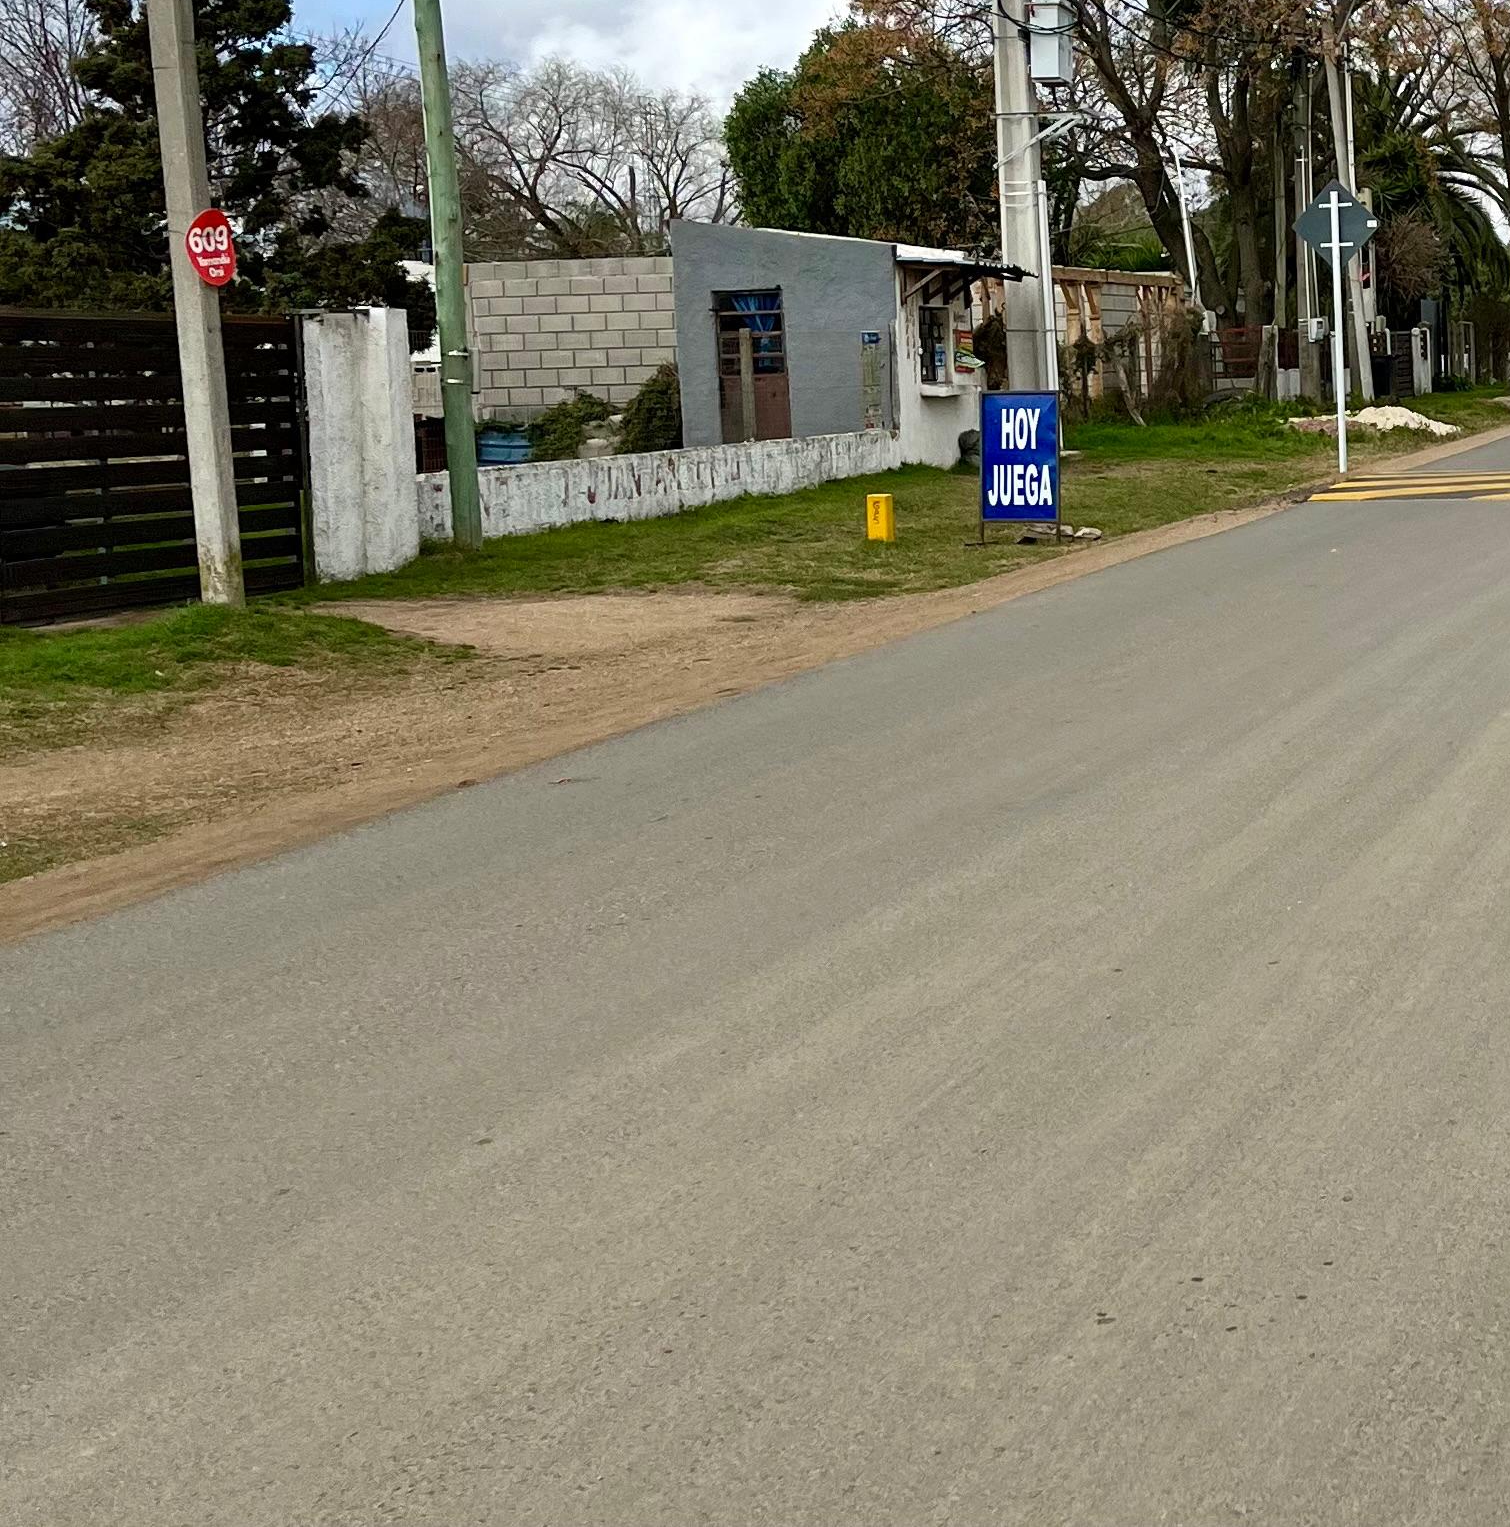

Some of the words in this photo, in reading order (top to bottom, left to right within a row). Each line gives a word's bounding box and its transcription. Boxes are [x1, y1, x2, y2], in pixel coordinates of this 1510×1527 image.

[189, 225, 228, 253] 609
[1001, 407, 1040, 450] HOY
[988, 463, 1053, 506] JUEGA
